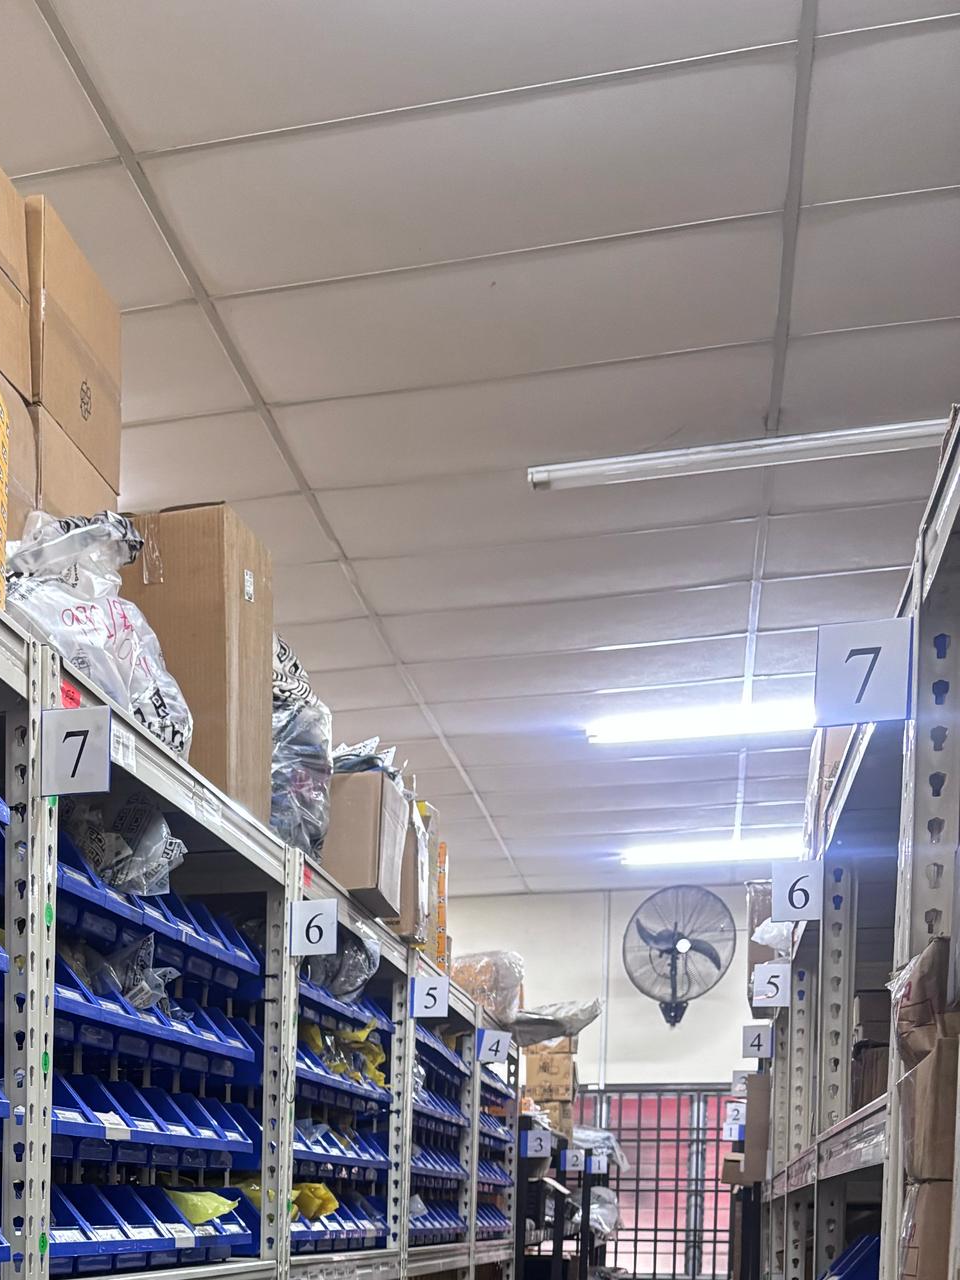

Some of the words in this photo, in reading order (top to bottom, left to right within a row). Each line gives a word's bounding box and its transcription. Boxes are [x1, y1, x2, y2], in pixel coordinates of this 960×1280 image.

[844, 646, 882, 704] 7
[61, 729, 90, 779] 7
[787, 875, 810, 910] 6
[304, 912, 325, 945] 6
[424, 986, 439, 1010] 5
[766, 974, 781, 999] 5
[488, 1039, 501, 1057] 4
[749, 1032, 764, 1052] 4
[732, 1108, 740, 1121] 2
[533, 1137, 544, 1152] 3
[572, 1152, 580, 1167] 2
